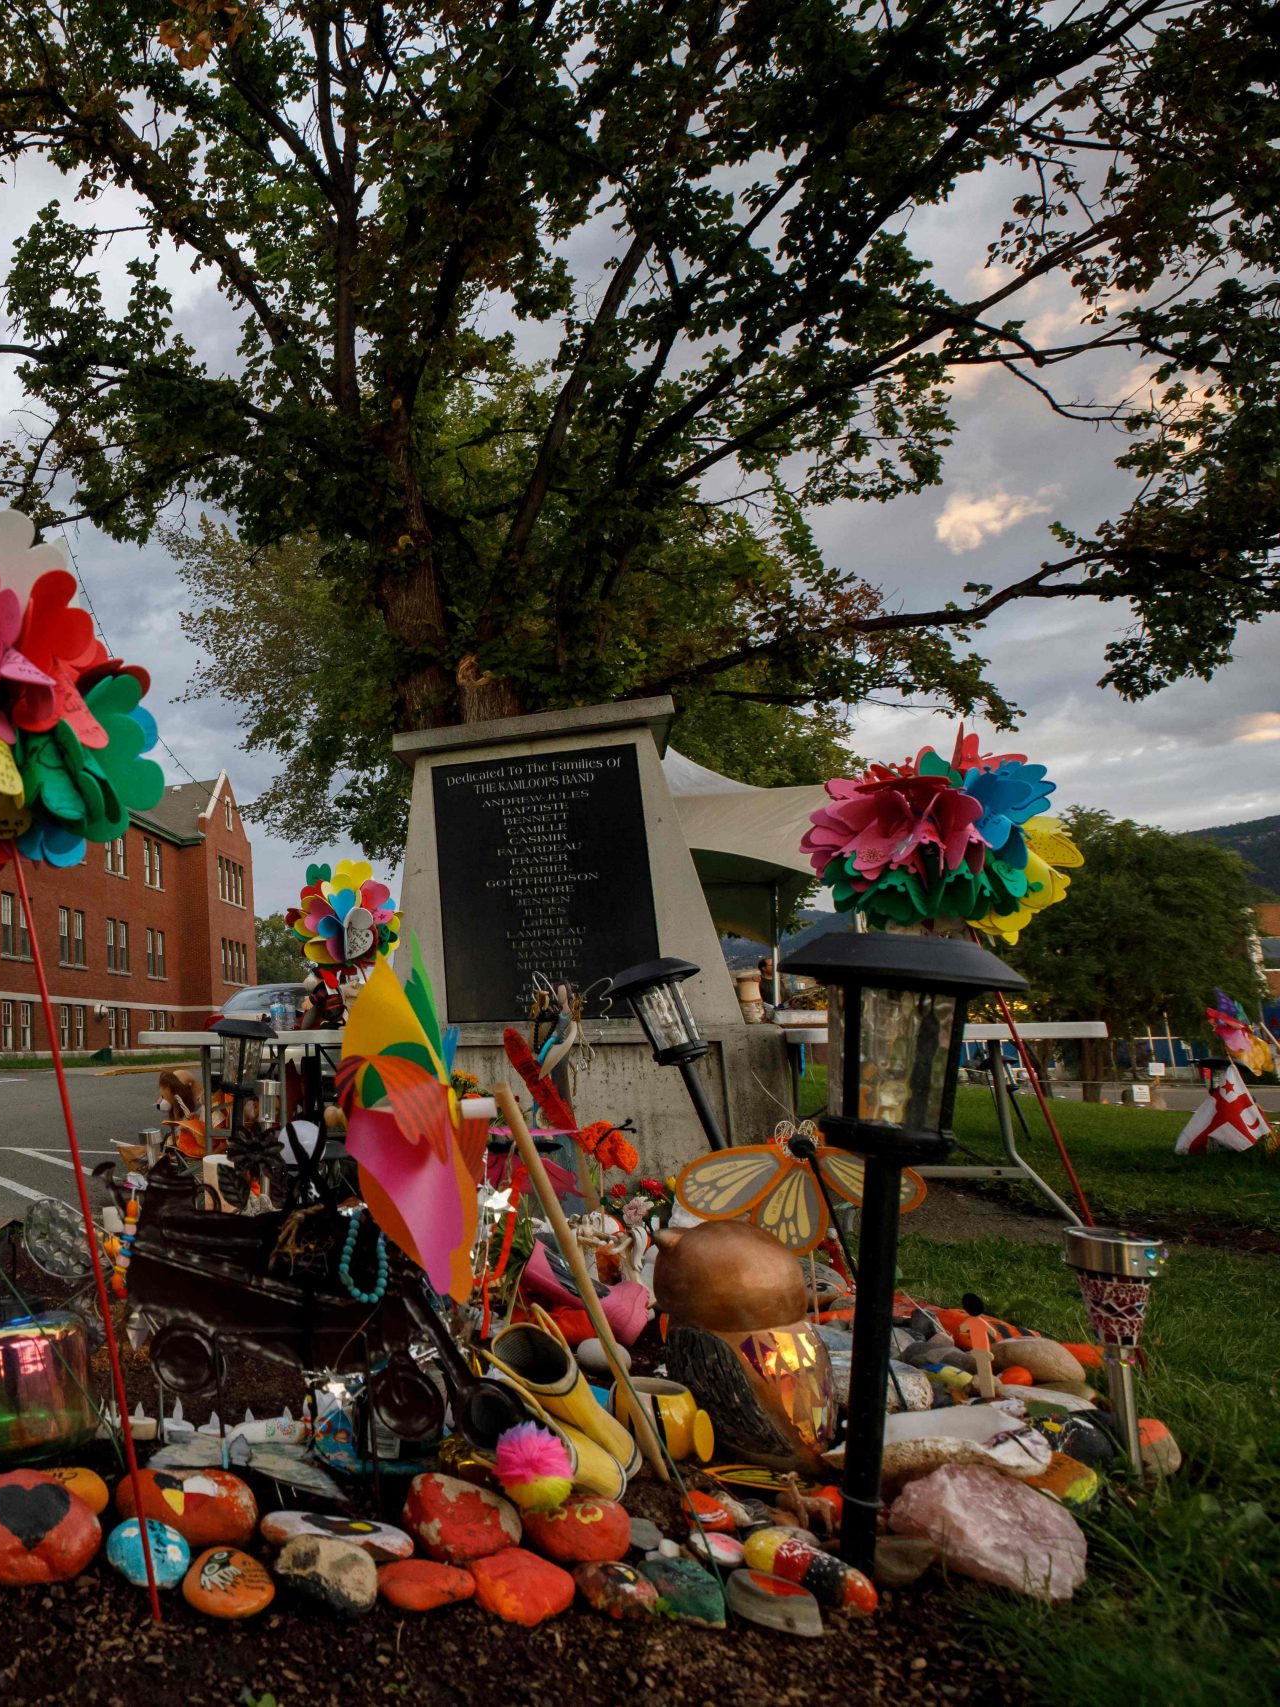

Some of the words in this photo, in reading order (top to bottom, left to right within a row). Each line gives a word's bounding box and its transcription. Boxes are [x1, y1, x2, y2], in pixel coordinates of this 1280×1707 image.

[446, 766, 504, 787] Dedicated
[508, 766, 523, 778] To
[525, 763, 548, 774] The
[552, 758, 603, 772] Families
[606, 756, 621, 768] Of
[474, 782, 497, 794] THE
[499, 776, 559, 792] KAMLOOPS
[562, 772, 594, 784] BAND
[502, 802, 569, 816] BAPTISTE
[503, 812, 569, 826] BENNETT
[507, 823, 568, 836] CAMILLE
[510, 833, 567, 846] CASIMIR
[512, 854, 568, 866] FRASER
[510, 864, 573, 876] GABRIEL
[486, 872, 599, 888] GOTTFRIEDSON
[510, 885, 575, 896] ISADORE
